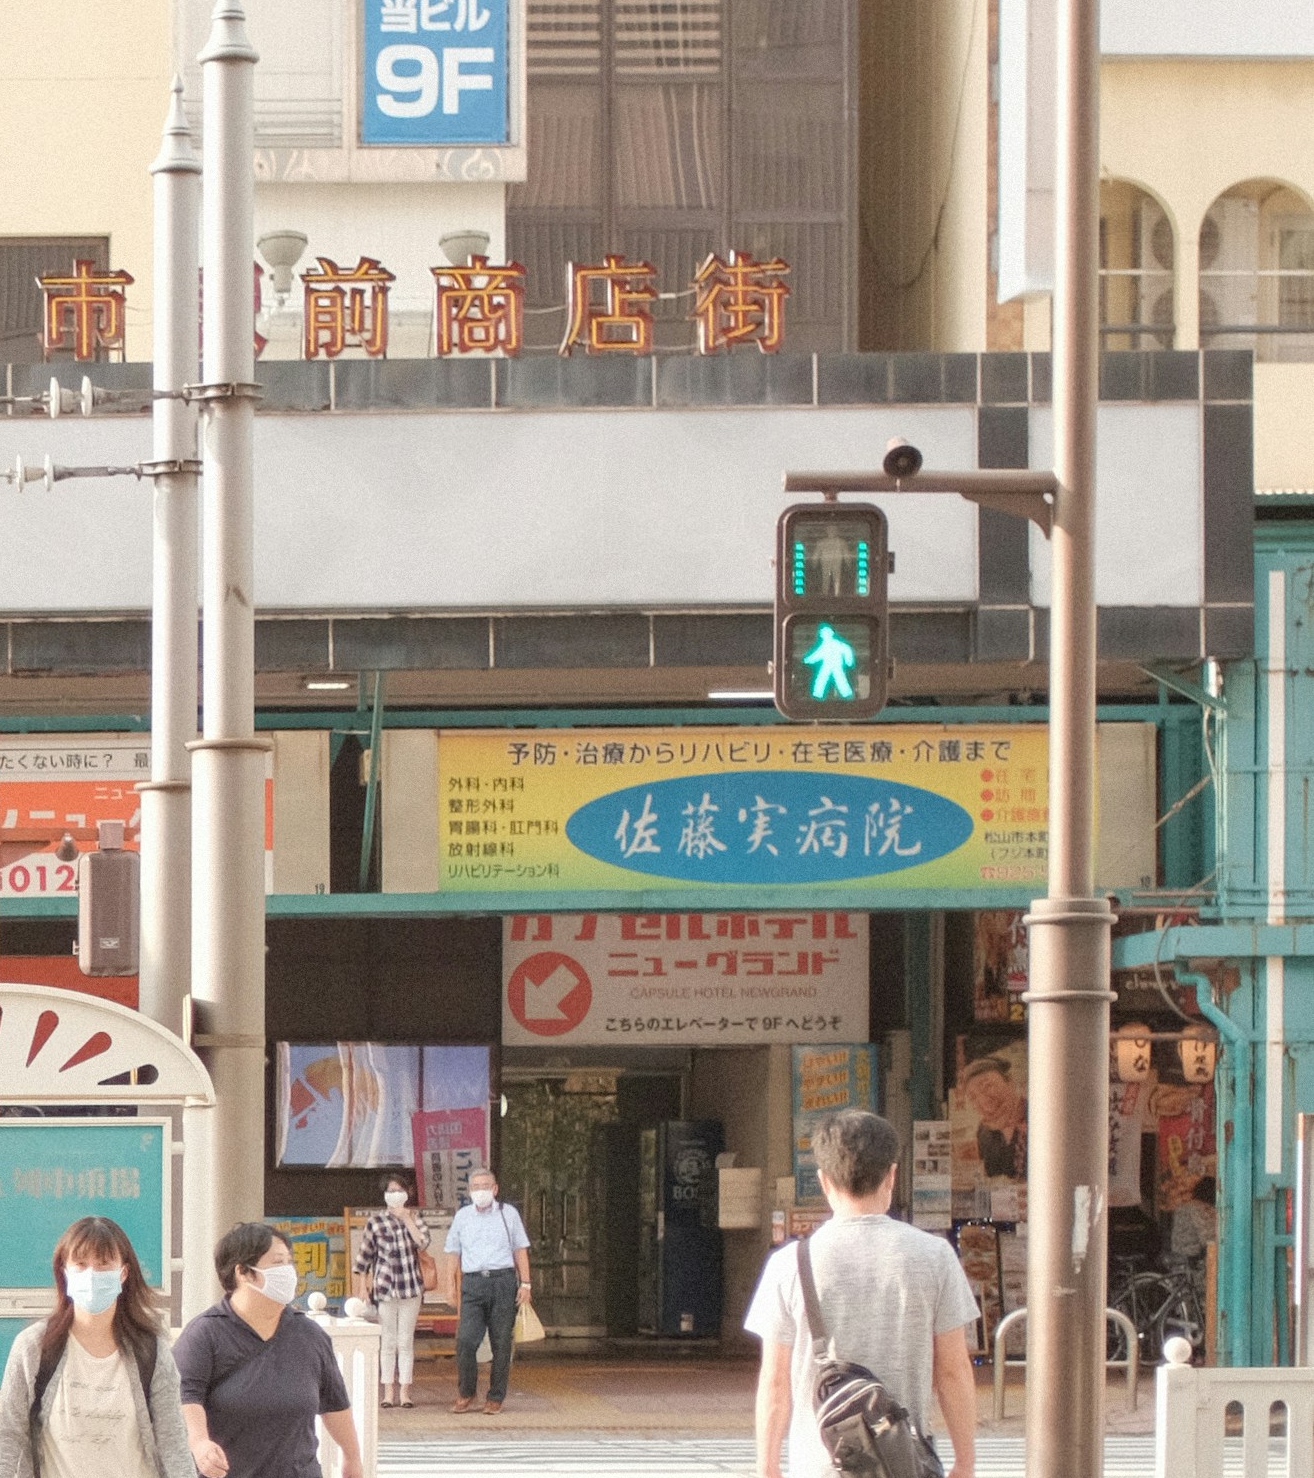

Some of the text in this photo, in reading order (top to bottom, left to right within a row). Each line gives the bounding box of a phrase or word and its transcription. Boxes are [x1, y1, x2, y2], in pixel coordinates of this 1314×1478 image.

[374, 43, 495, 120] 9F
[34, 250, 792, 362] 市前商店街
[448, 776, 525, 792] 外科・内科
[448, 798, 515, 814] 整形外科
[614, 792, 922, 859] 佐藤実病院
[448, 842, 515, 858] 放射線科
[448, 863, 560, 879] リハビリテーション科
[608, 949, 840, 976] ニューグランド
[630, 986, 817, 1000] CAPSULE HOTEL NEWGRAND
[762, 1017, 783, 1031] 9F
